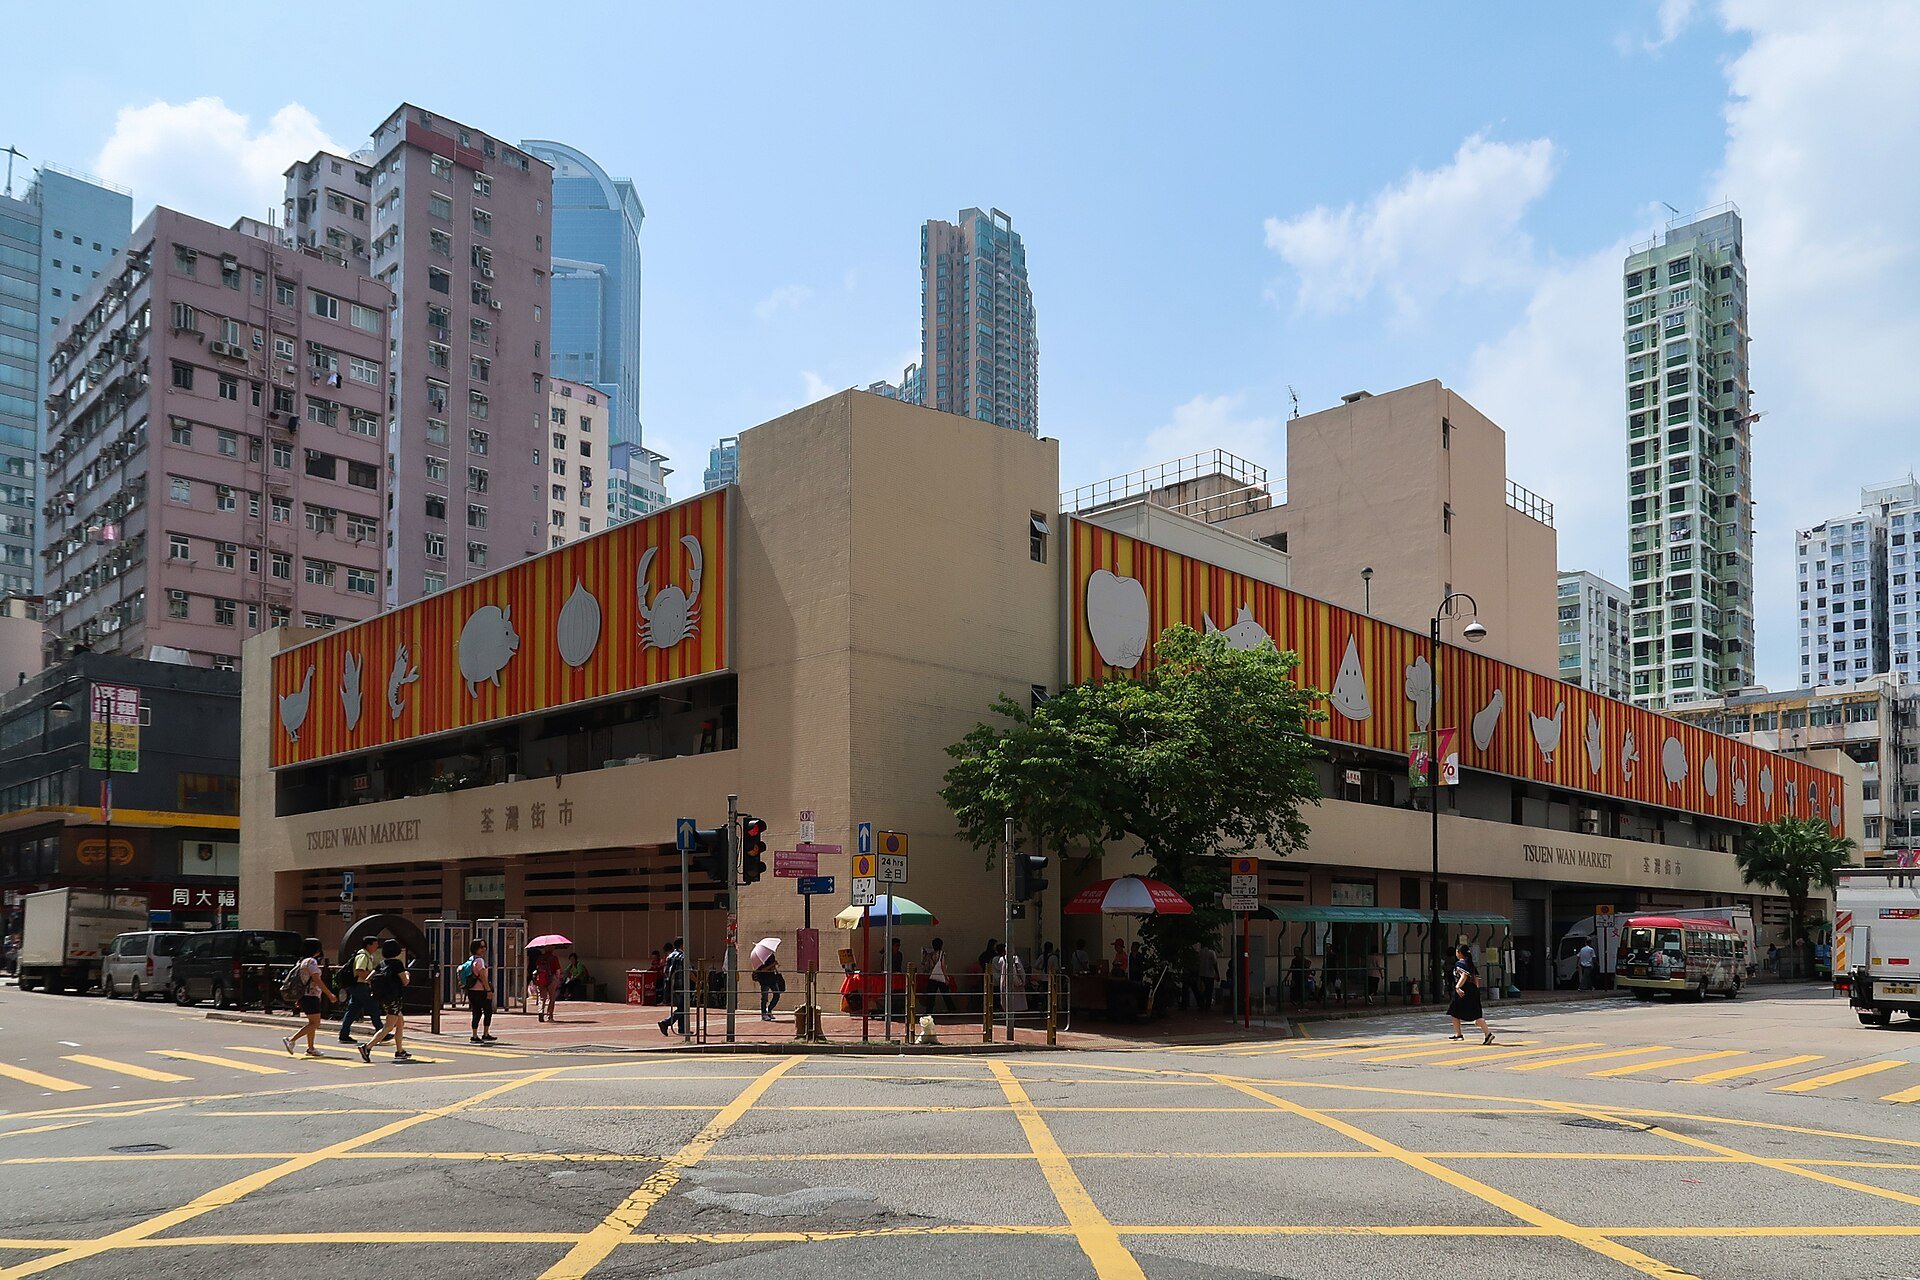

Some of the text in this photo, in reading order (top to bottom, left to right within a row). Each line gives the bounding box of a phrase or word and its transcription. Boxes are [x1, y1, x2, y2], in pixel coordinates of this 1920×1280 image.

[1442, 763, 1455, 776] 70
[480, 798, 574, 834] 荃灣街市
[306, 819, 422, 850] TSUEN WAN MARKET
[881, 857, 904, 867] 24 hrs
[1523, 844, 1613, 869] TSUEN WAN MARKET
[1643, 856, 1682, 877] 荃灣街市
[884, 869, 902, 880] 全日
[344, 874, 352, 891] P
[866, 879, 871, 888] 7
[172, 888, 236, 907] 周大福
[866, 893, 874, 904] 12
[1627, 953, 1636, 965] 2
